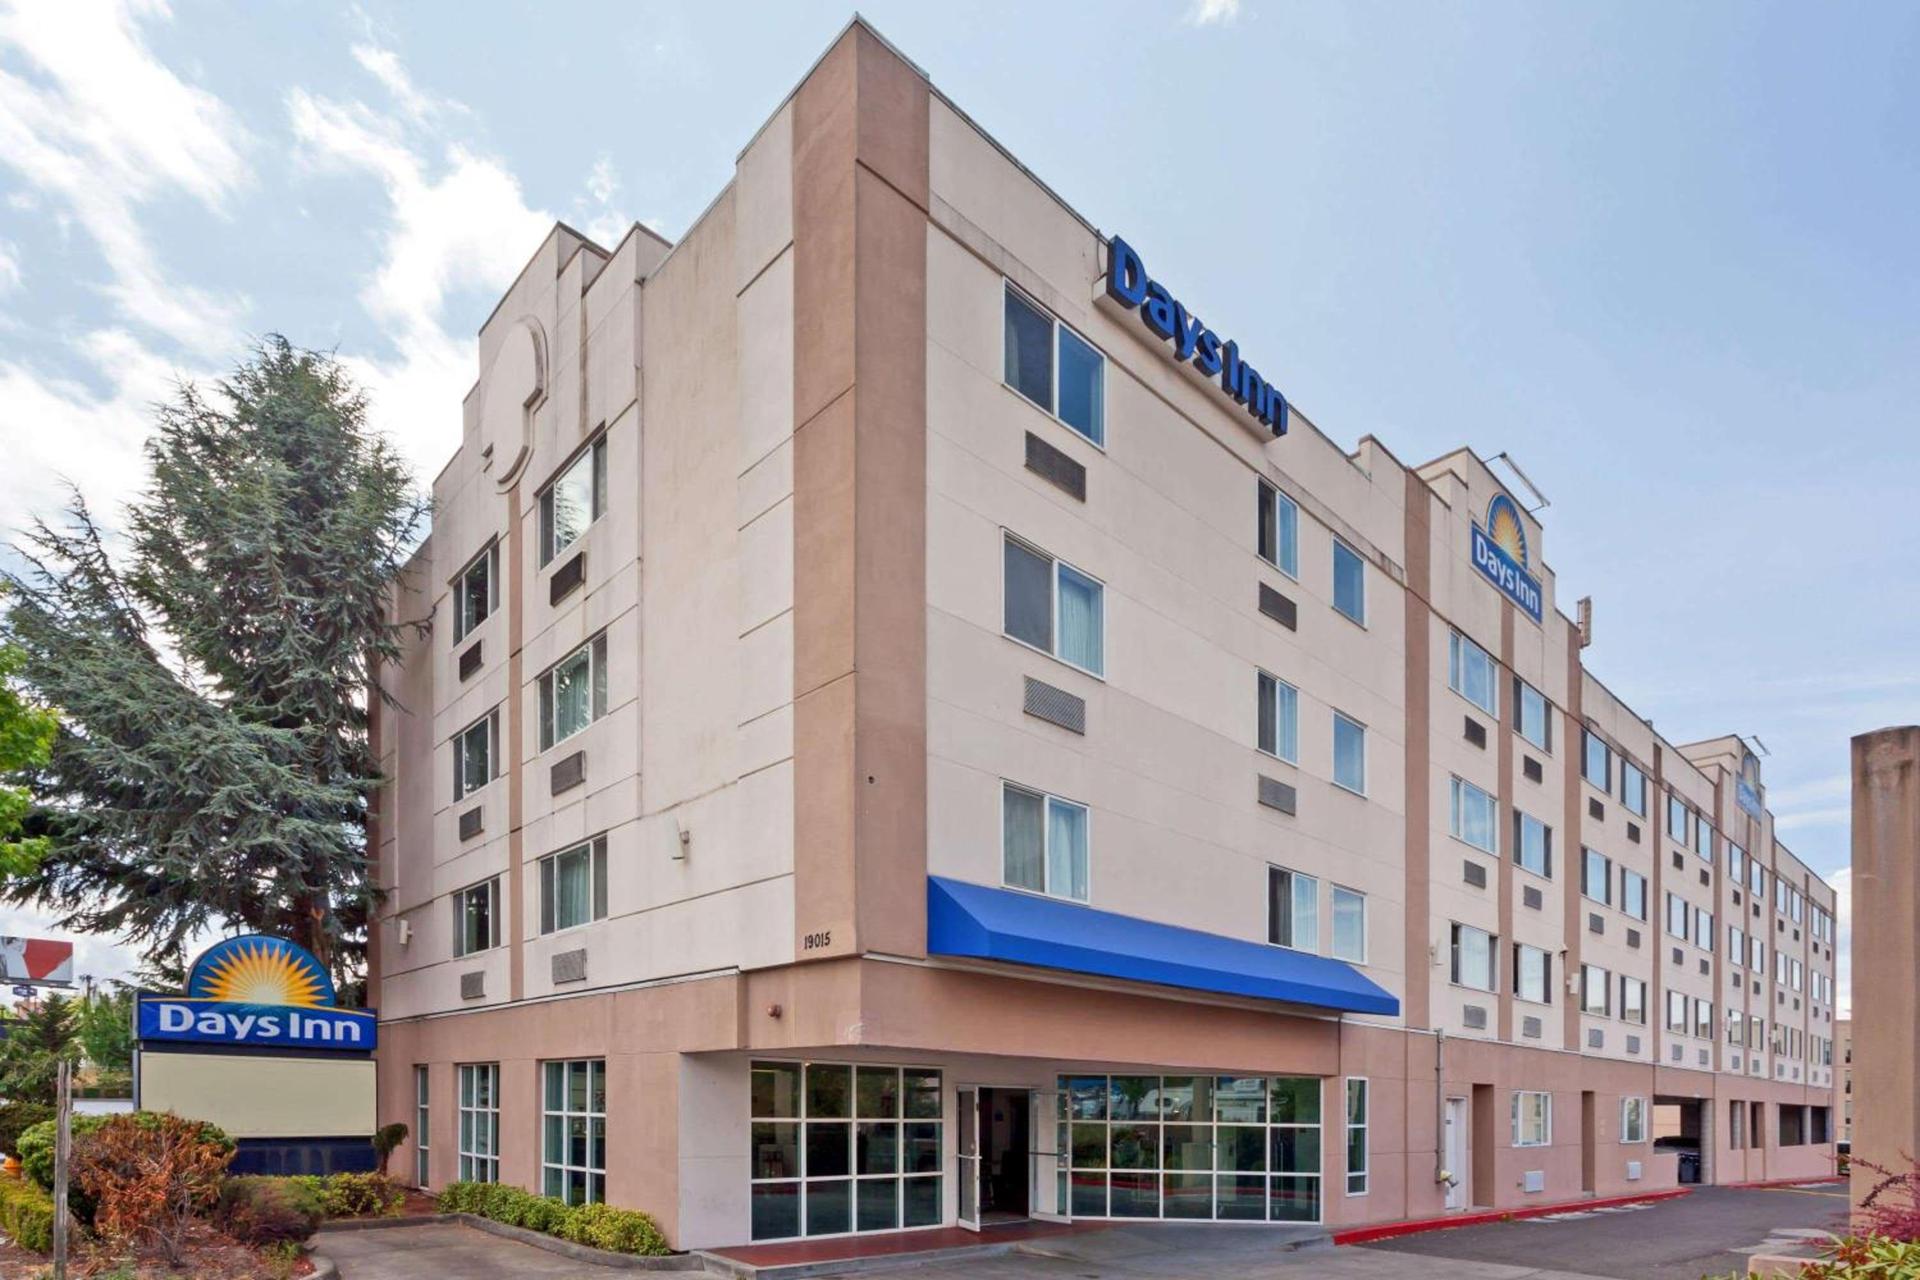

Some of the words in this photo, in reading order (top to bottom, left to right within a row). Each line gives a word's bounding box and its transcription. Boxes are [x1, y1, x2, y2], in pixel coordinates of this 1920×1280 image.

[1106, 234, 1222, 378] Days
[1222, 339, 1288, 437] Inn
[1476, 533, 1514, 591] Days
[1515, 571, 1539, 613] Inn
[804, 931, 831, 950] 19015
[159, 1004, 280, 1040] Days
[289, 1013, 361, 1042] Inn
